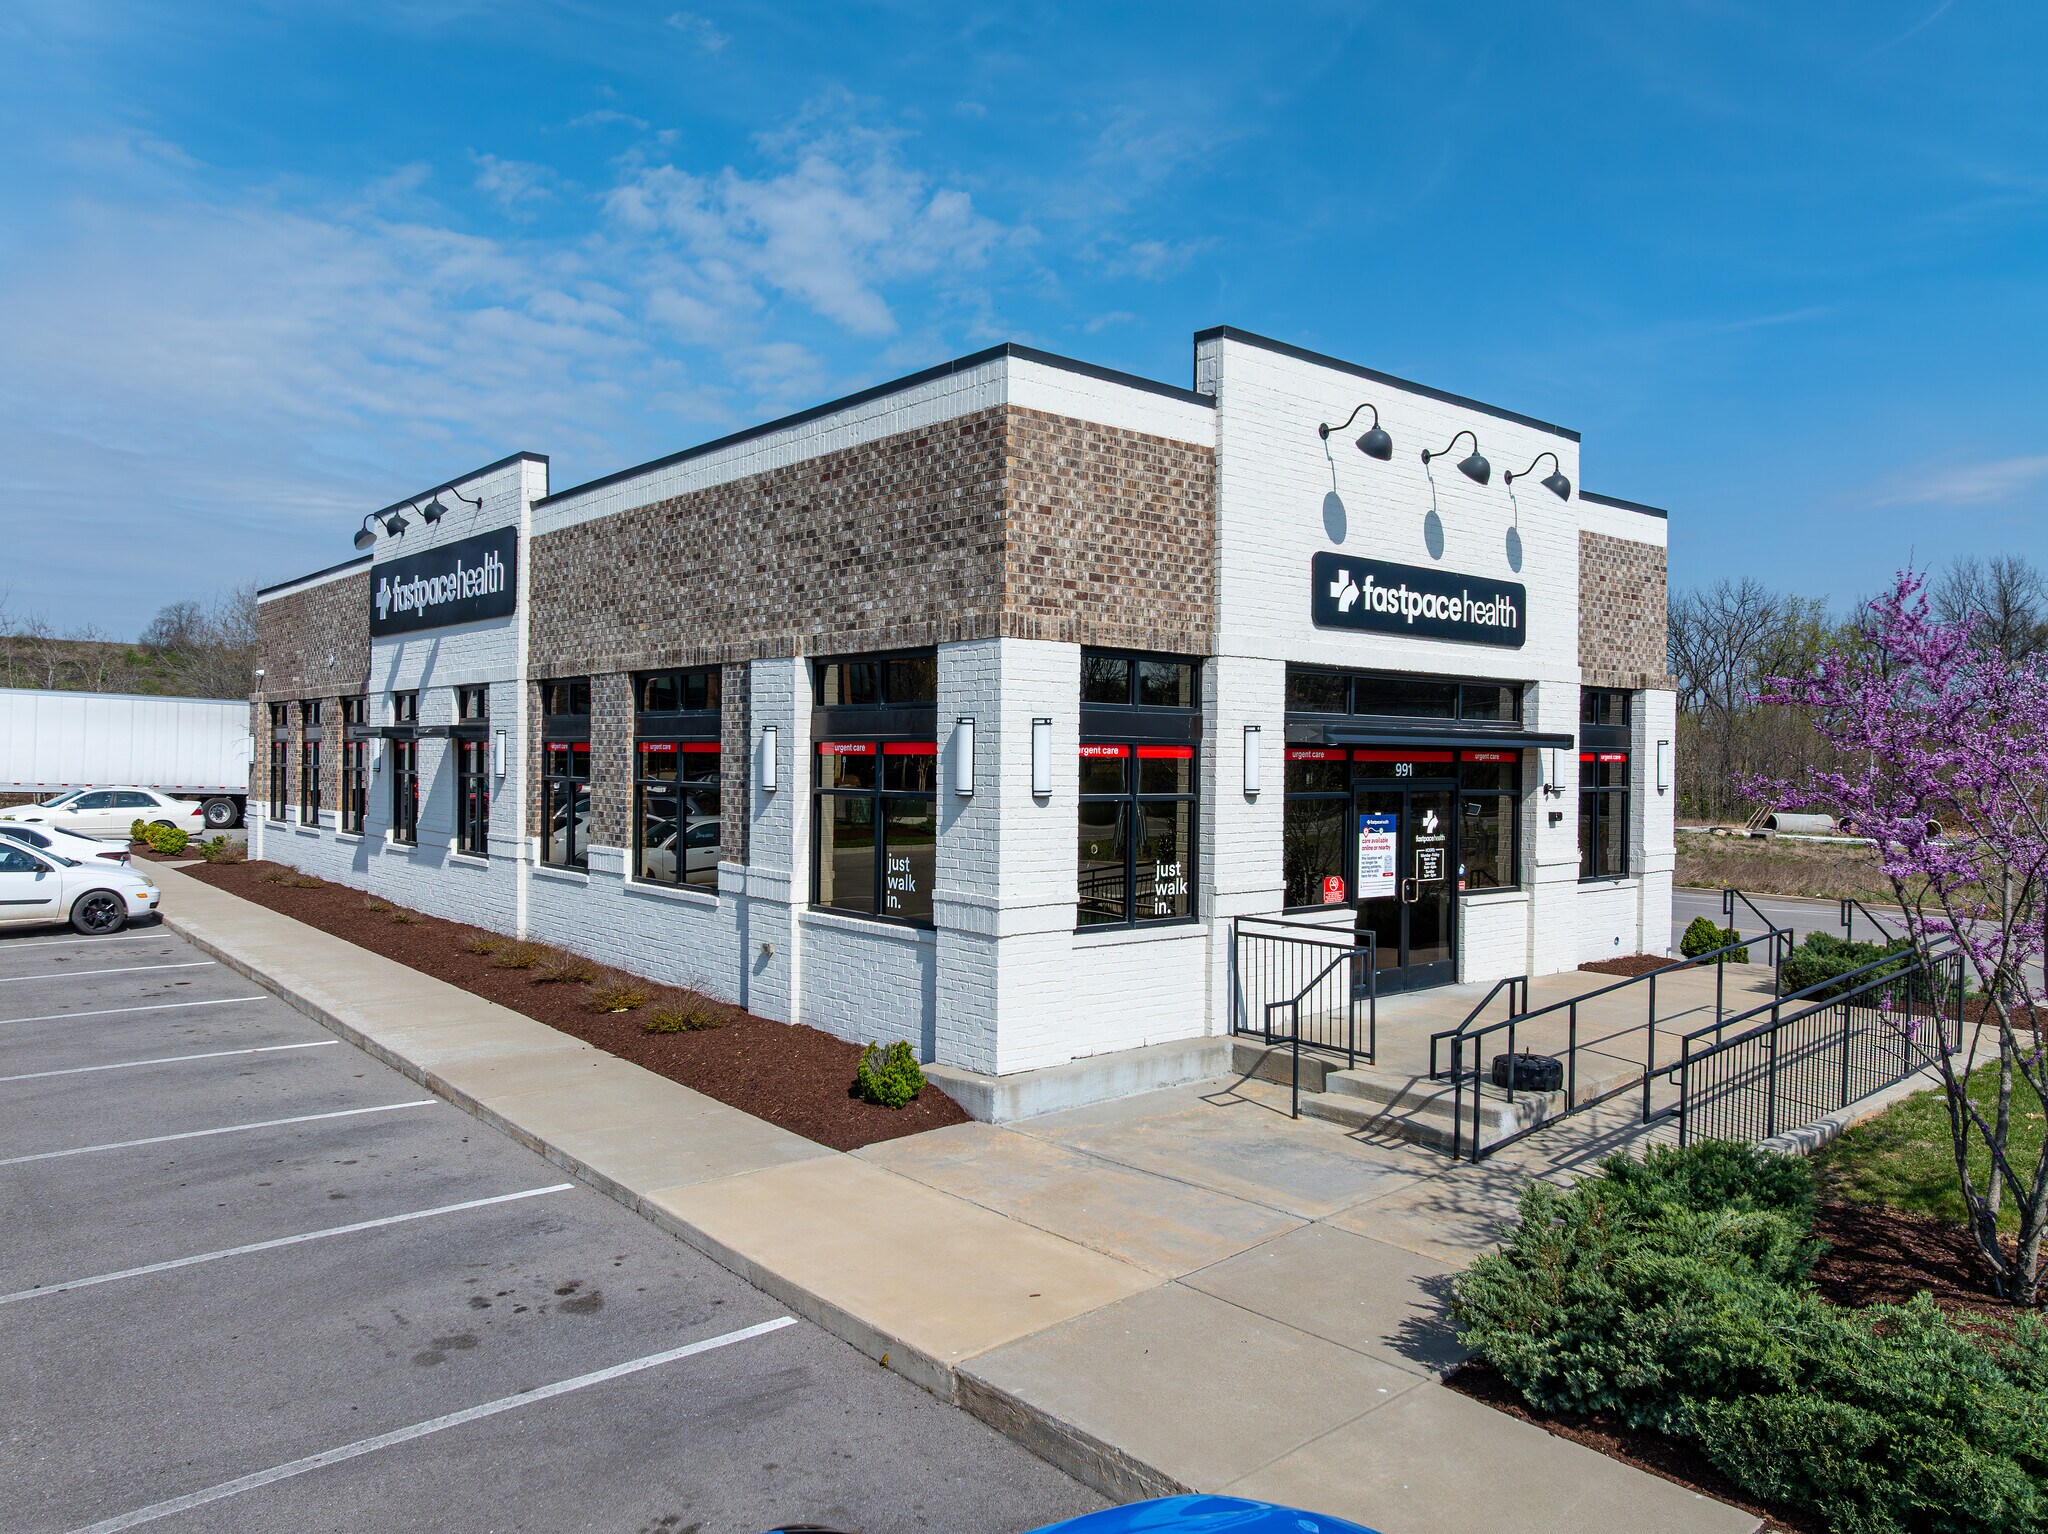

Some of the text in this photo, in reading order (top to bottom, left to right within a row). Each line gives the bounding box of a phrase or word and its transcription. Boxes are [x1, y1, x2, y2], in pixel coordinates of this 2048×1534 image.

[392, 550, 504, 617] fastpacehealth
[1363, 575, 1517, 629] fastpacehealth
[834, 744, 852, 754] urgent
[1102, 747, 1119, 755] care
[1292, 751, 1311, 759] urgent
[1475, 753, 1490, 761] urgent
[1395, 763, 1412, 777] 991
[887, 852, 910, 875] just
[1155, 860, 1182, 882] just
[887, 873, 916, 892] walk
[1155, 877, 1188, 896] walk
[887, 889, 901, 909] in.
[1154, 897, 1171, 915] in.
